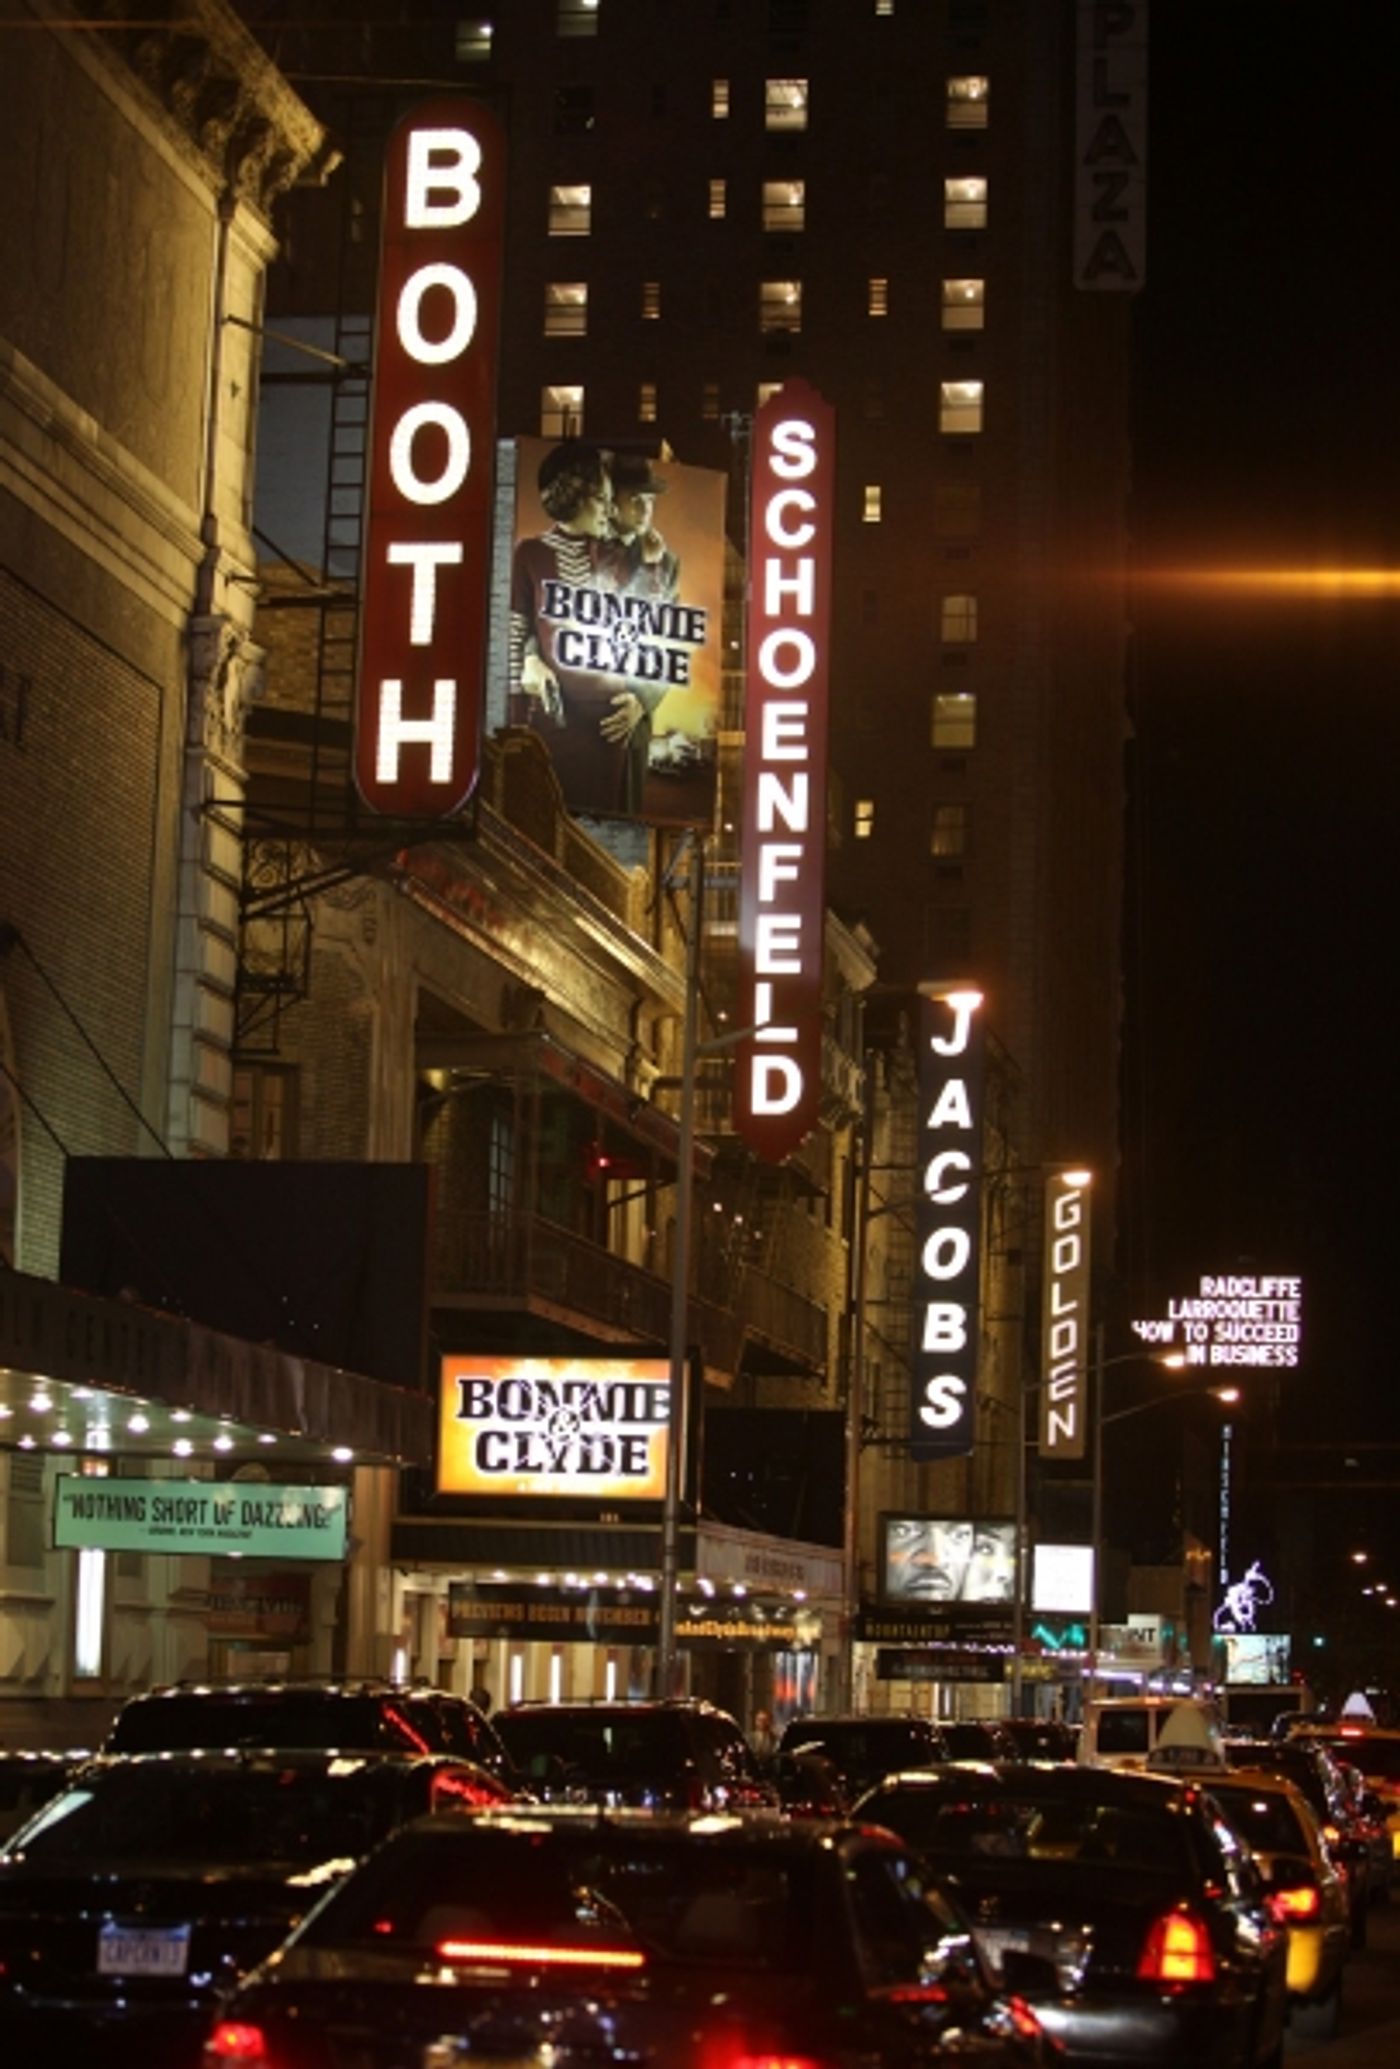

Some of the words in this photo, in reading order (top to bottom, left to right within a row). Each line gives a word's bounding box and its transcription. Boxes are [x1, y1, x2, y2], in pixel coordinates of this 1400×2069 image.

[1084, 1, 1138, 280] PLAZA
[377, 129, 481, 783] BOOTH
[541, 581, 708, 644] BONNIE
[557, 629, 691, 685] CLYDE
[751, 421, 816, 1114] SCHOENFELD
[919, 1003, 973, 1428] JACOBS
[1200, 1276, 1302, 1298] RADCLIFFE
[1047, 1191, 1081, 1446] GOLDEN
[1182, 1322, 1209, 1343] TO
[1213, 1321, 1300, 1344] SUCCEED
[1210, 1344, 1299, 1367] BUSINESS
[456, 1378, 671, 1424] BONNIE
[475, 1430, 651, 1476] CLYDE
[151, 1496, 208, 1524] SHORT
[213, 1500, 235, 1527] OF
